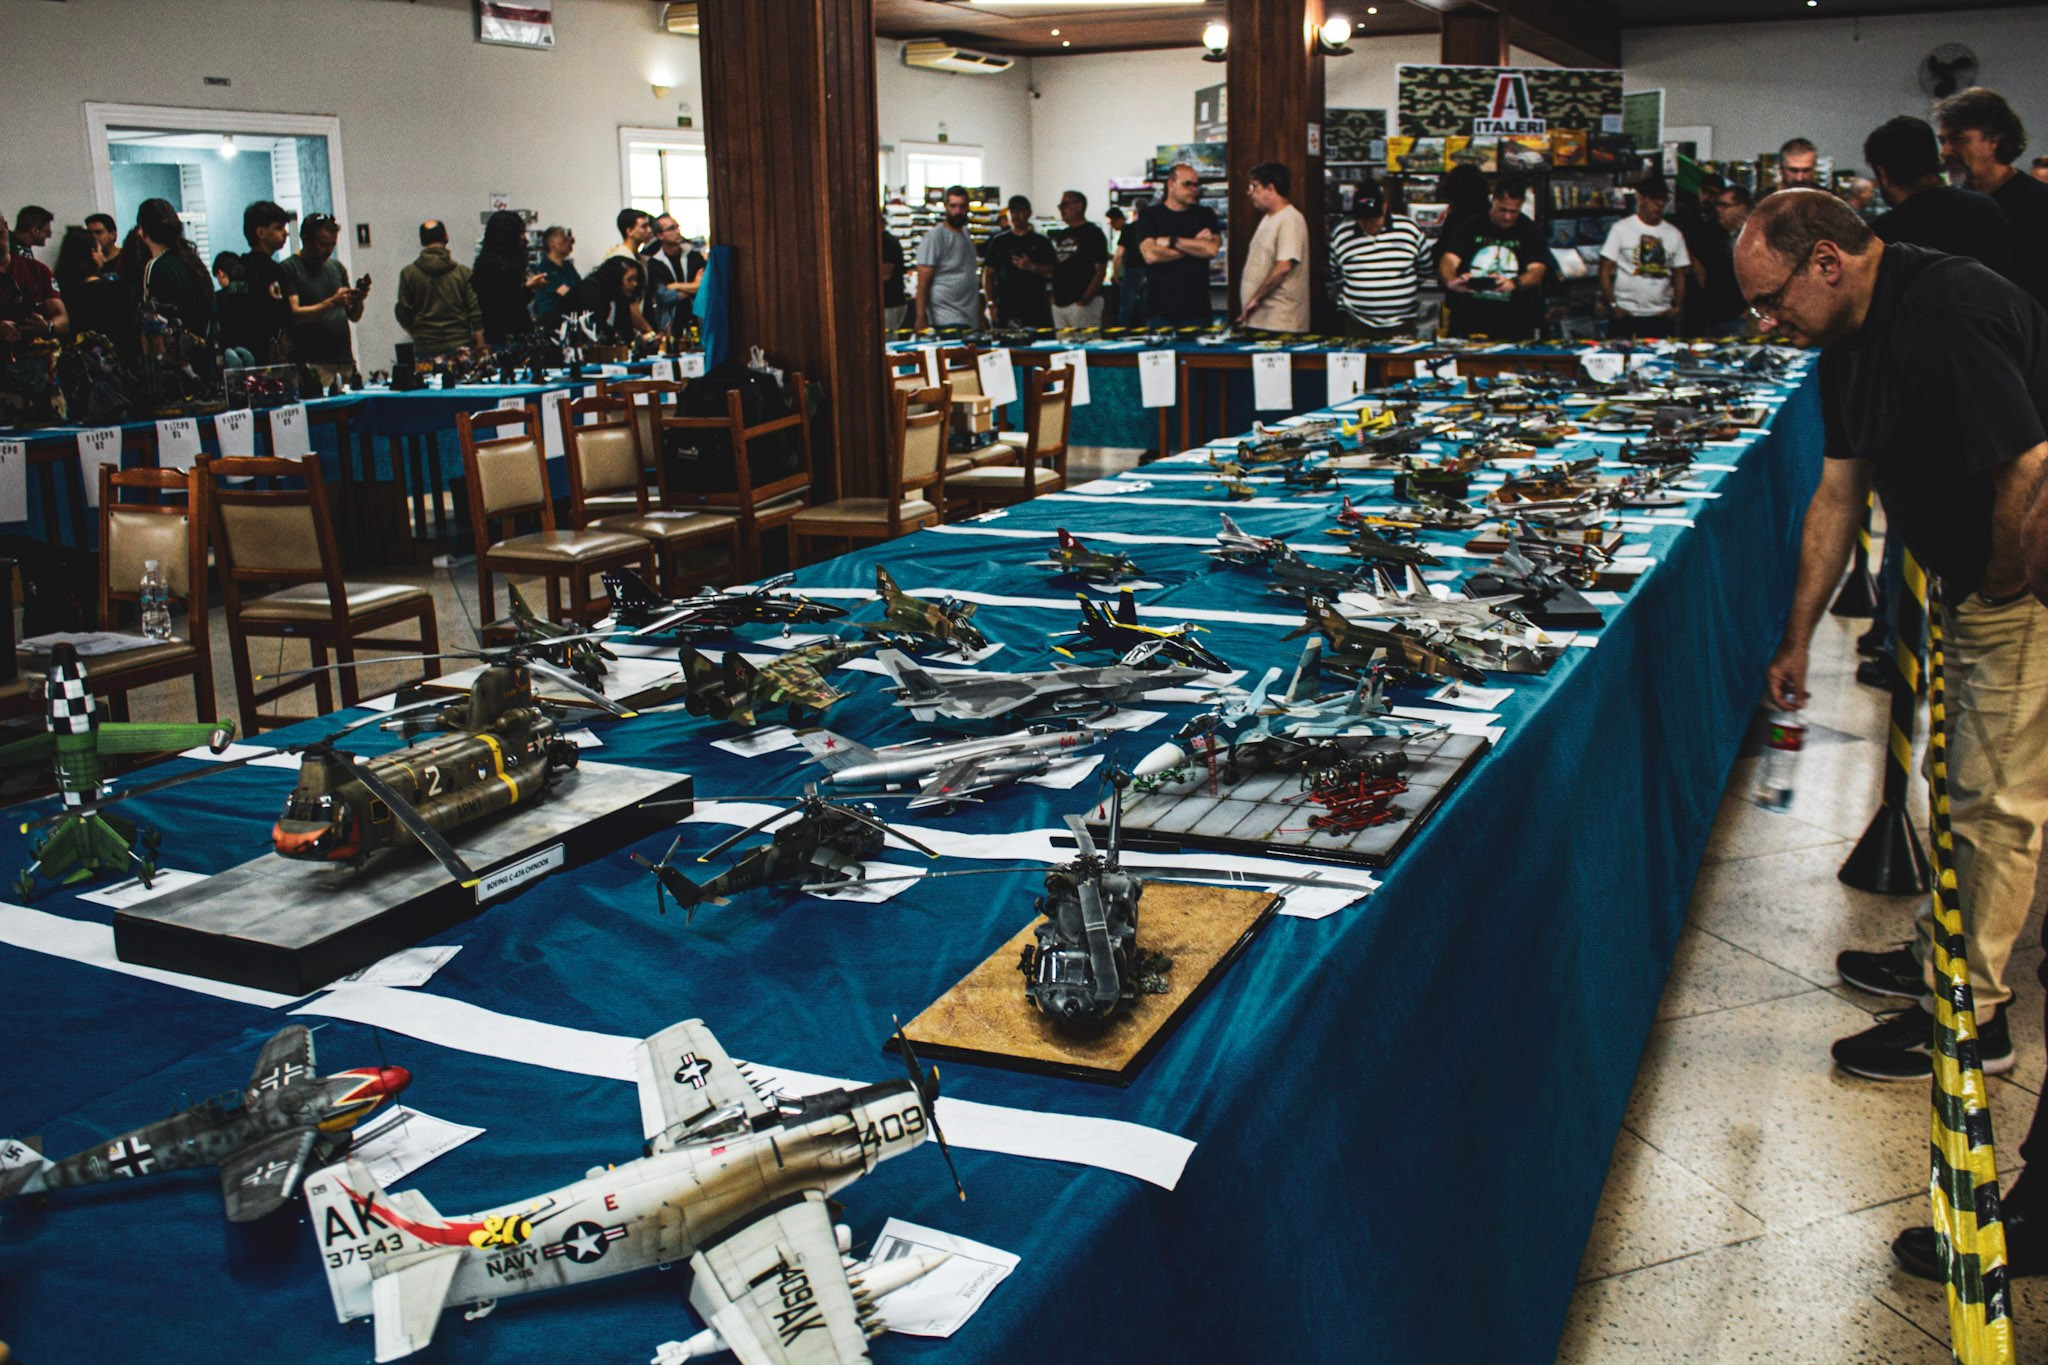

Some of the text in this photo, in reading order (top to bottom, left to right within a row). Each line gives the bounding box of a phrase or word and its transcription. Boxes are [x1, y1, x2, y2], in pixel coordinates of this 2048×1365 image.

[1476, 121, 1545, 133] ITALERI
[1312, 596, 1324, 608] FG
[424, 765, 443, 797] 2
[486, 876, 509, 891] BOEING
[525, 858, 549, 874] CHINOOK
[862, 1105, 925, 1147] 409
[326, 1190, 389, 1247] AK
[604, 1193, 619, 1212] E
[326, 1233, 404, 1269] 37543
[486, 1248, 538, 1277] NAVY
